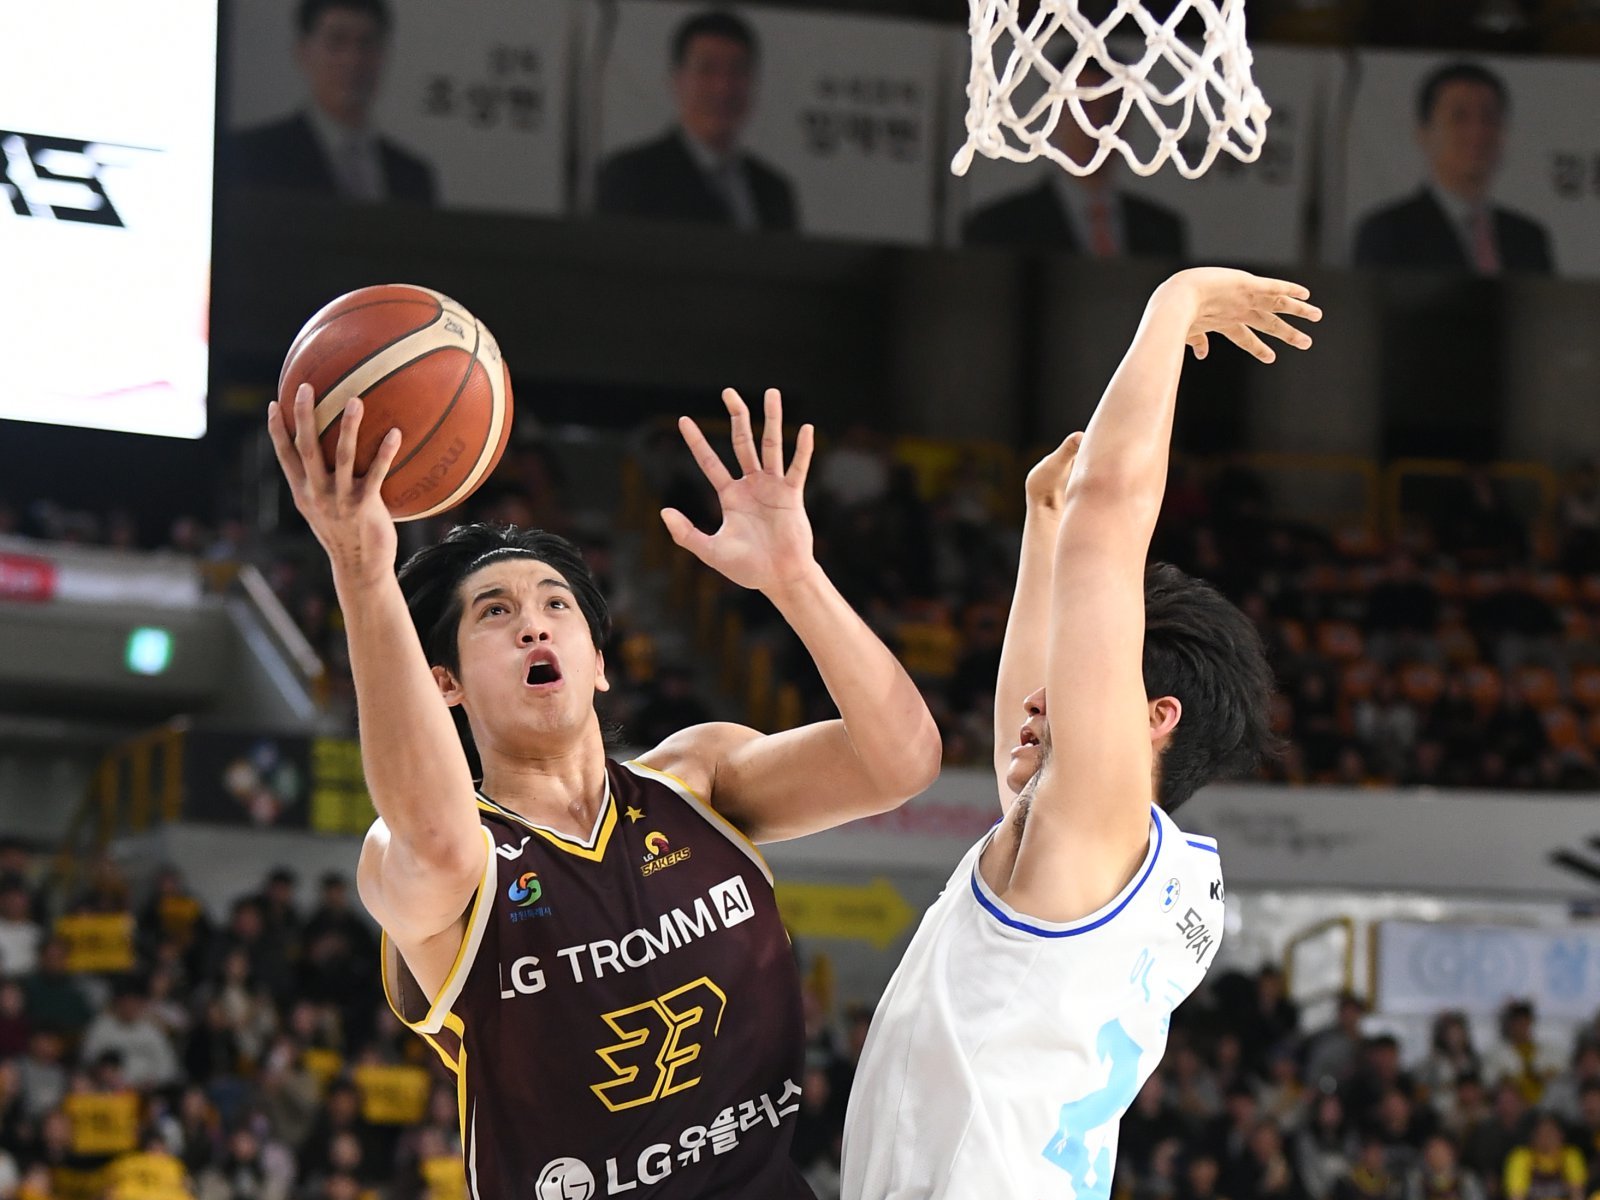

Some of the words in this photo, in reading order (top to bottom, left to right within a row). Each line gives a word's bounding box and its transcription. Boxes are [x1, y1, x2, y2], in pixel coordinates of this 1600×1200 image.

[641, 847, 691, 877] SAKERS
[643, 853, 654, 862] LG
[499, 956, 546, 999] LG
[557, 897, 717, 983] TROMM
[718, 880, 752, 924] AI
[1176, 907, 1213, 965] 도이치
[590, 976, 727, 1112] 33
